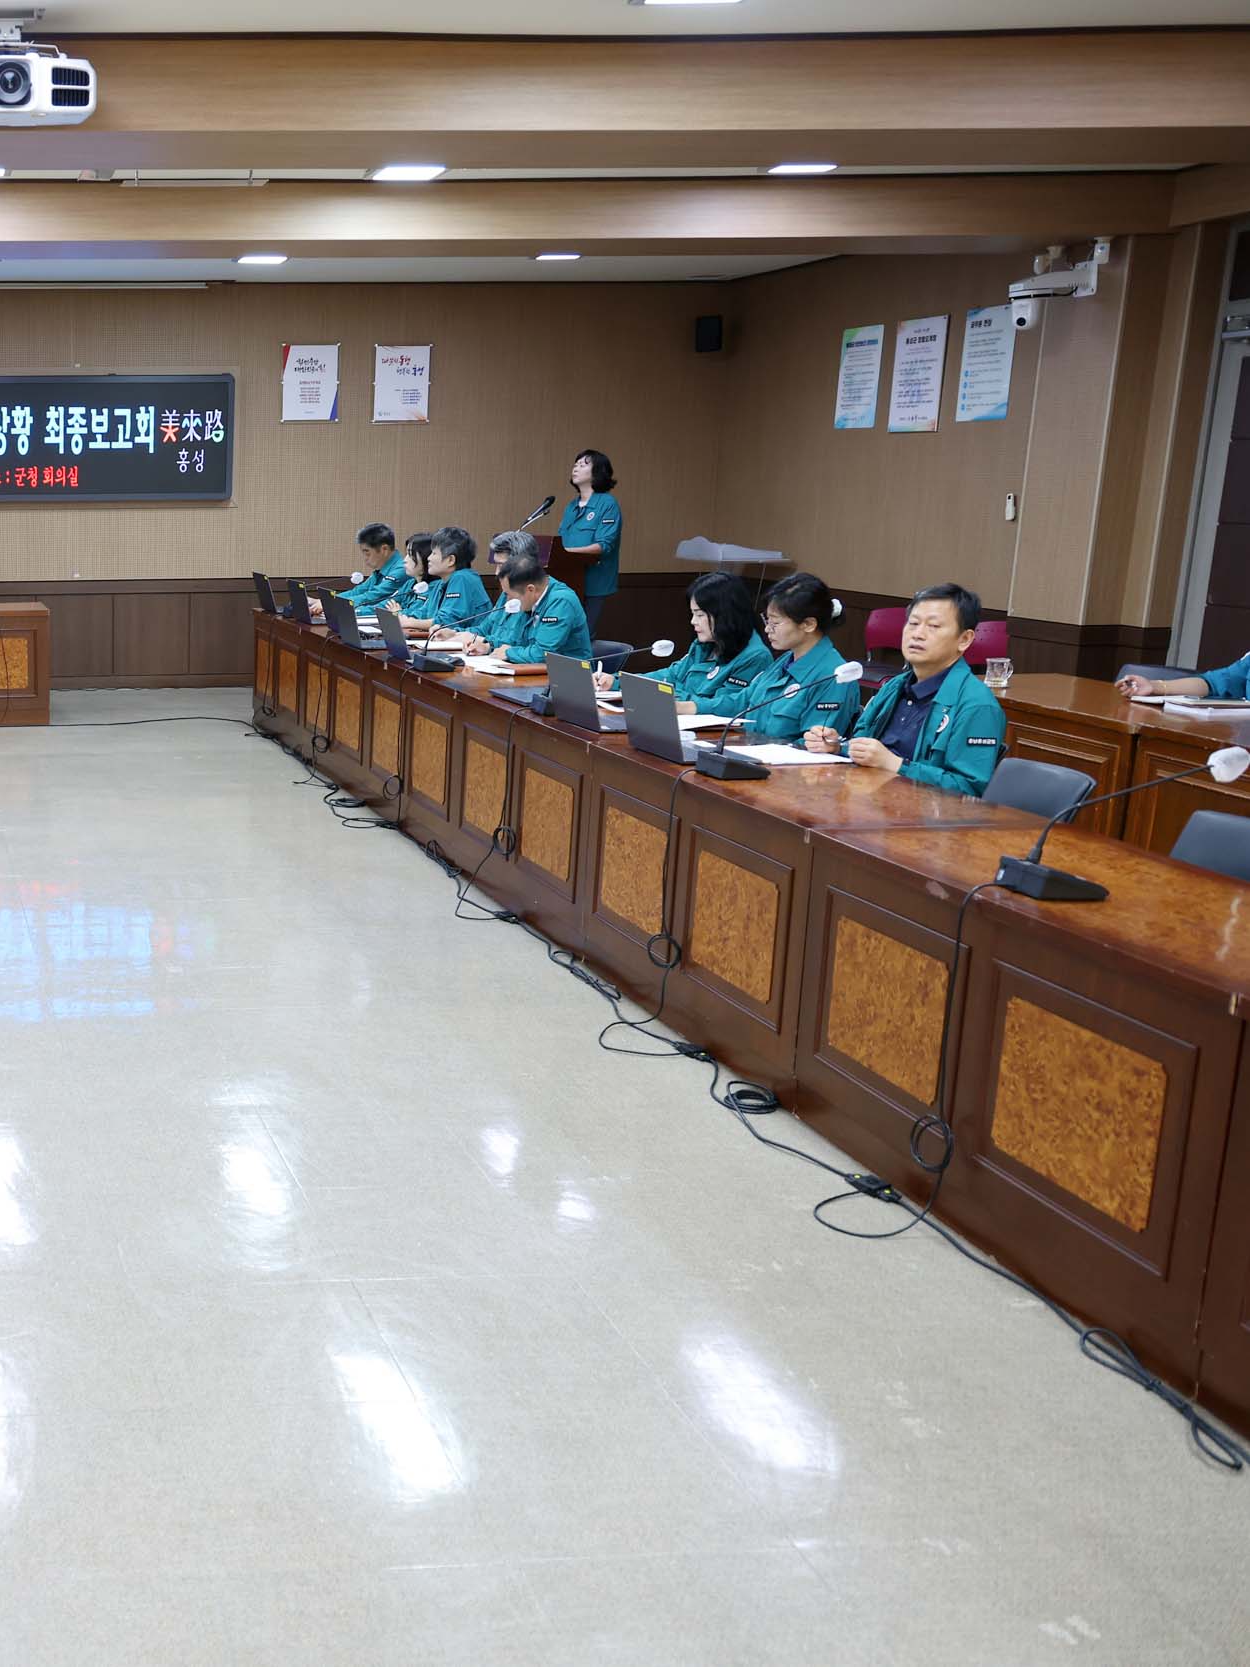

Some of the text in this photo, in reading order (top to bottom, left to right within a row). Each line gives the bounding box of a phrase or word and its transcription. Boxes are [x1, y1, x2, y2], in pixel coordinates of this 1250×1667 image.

[44, 406, 155, 455] 최종보고회
[176, 448, 205, 473] 홍성
[14, 466, 39, 488] 군청
[42, 466, 79, 488] 회의실
